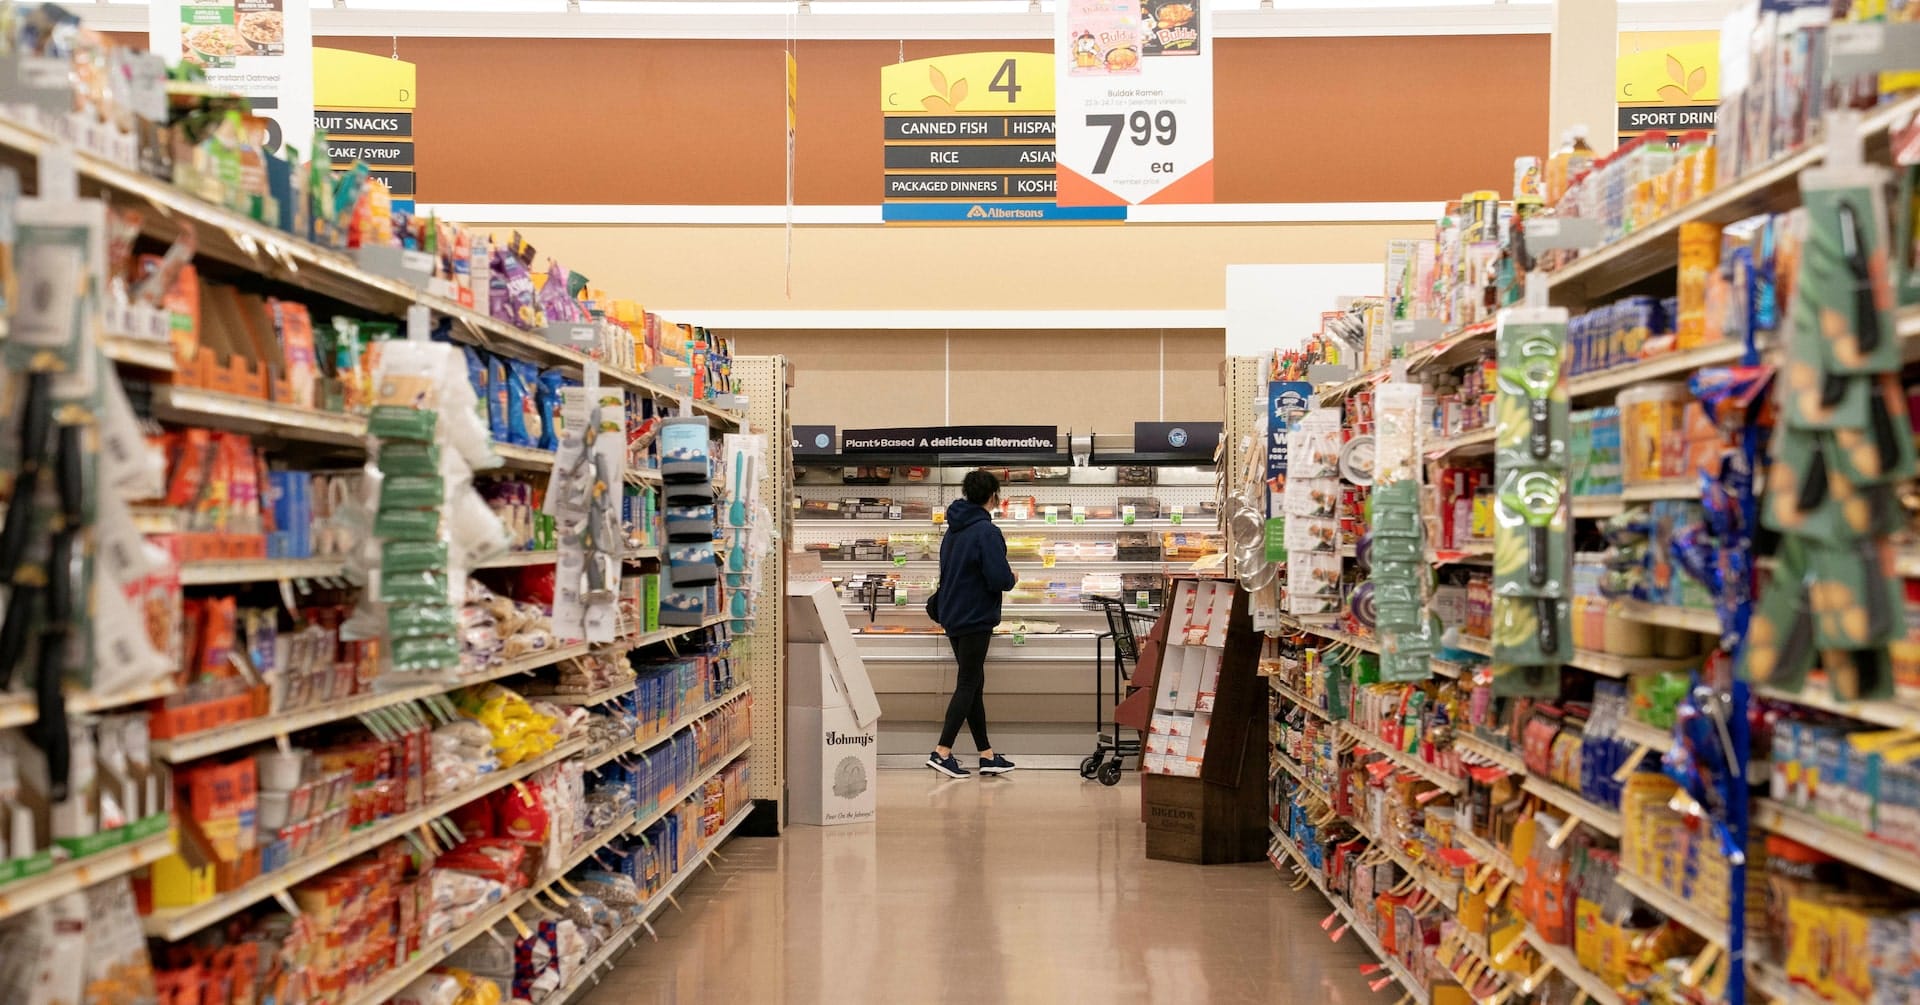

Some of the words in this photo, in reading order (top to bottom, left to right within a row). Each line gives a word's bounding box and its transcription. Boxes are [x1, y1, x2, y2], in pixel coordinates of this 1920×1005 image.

[246, 73, 281, 82] Oatmeal
[988, 59, 1022, 103] 4
[399, 89, 409, 102] D
[888, 92, 898, 106] C
[1107, 88, 1135, 97] Buldak
[1135, 89, 1164, 97] Ramen
[345, 118, 398, 131] SNACKS
[1631, 113, 1676, 126] SPORT
[901, 122, 956, 135] CANNED
[960, 122, 988, 134] FISH
[930, 151, 959, 164] RICE
[1151, 161, 1174, 174] ea
[892, 181, 948, 192] PACKAGED
[950, 181, 998, 192] DINNERS
[988, 208, 1044, 219] Albertsons
[845, 438, 874, 449] Plant
[881, 438, 915, 448] Based
[919, 437, 929, 448] A
[930, 436, 983, 448] delicious
[985, 436, 1054, 449] alternative.
[826, 731, 874, 747] Johnny's
